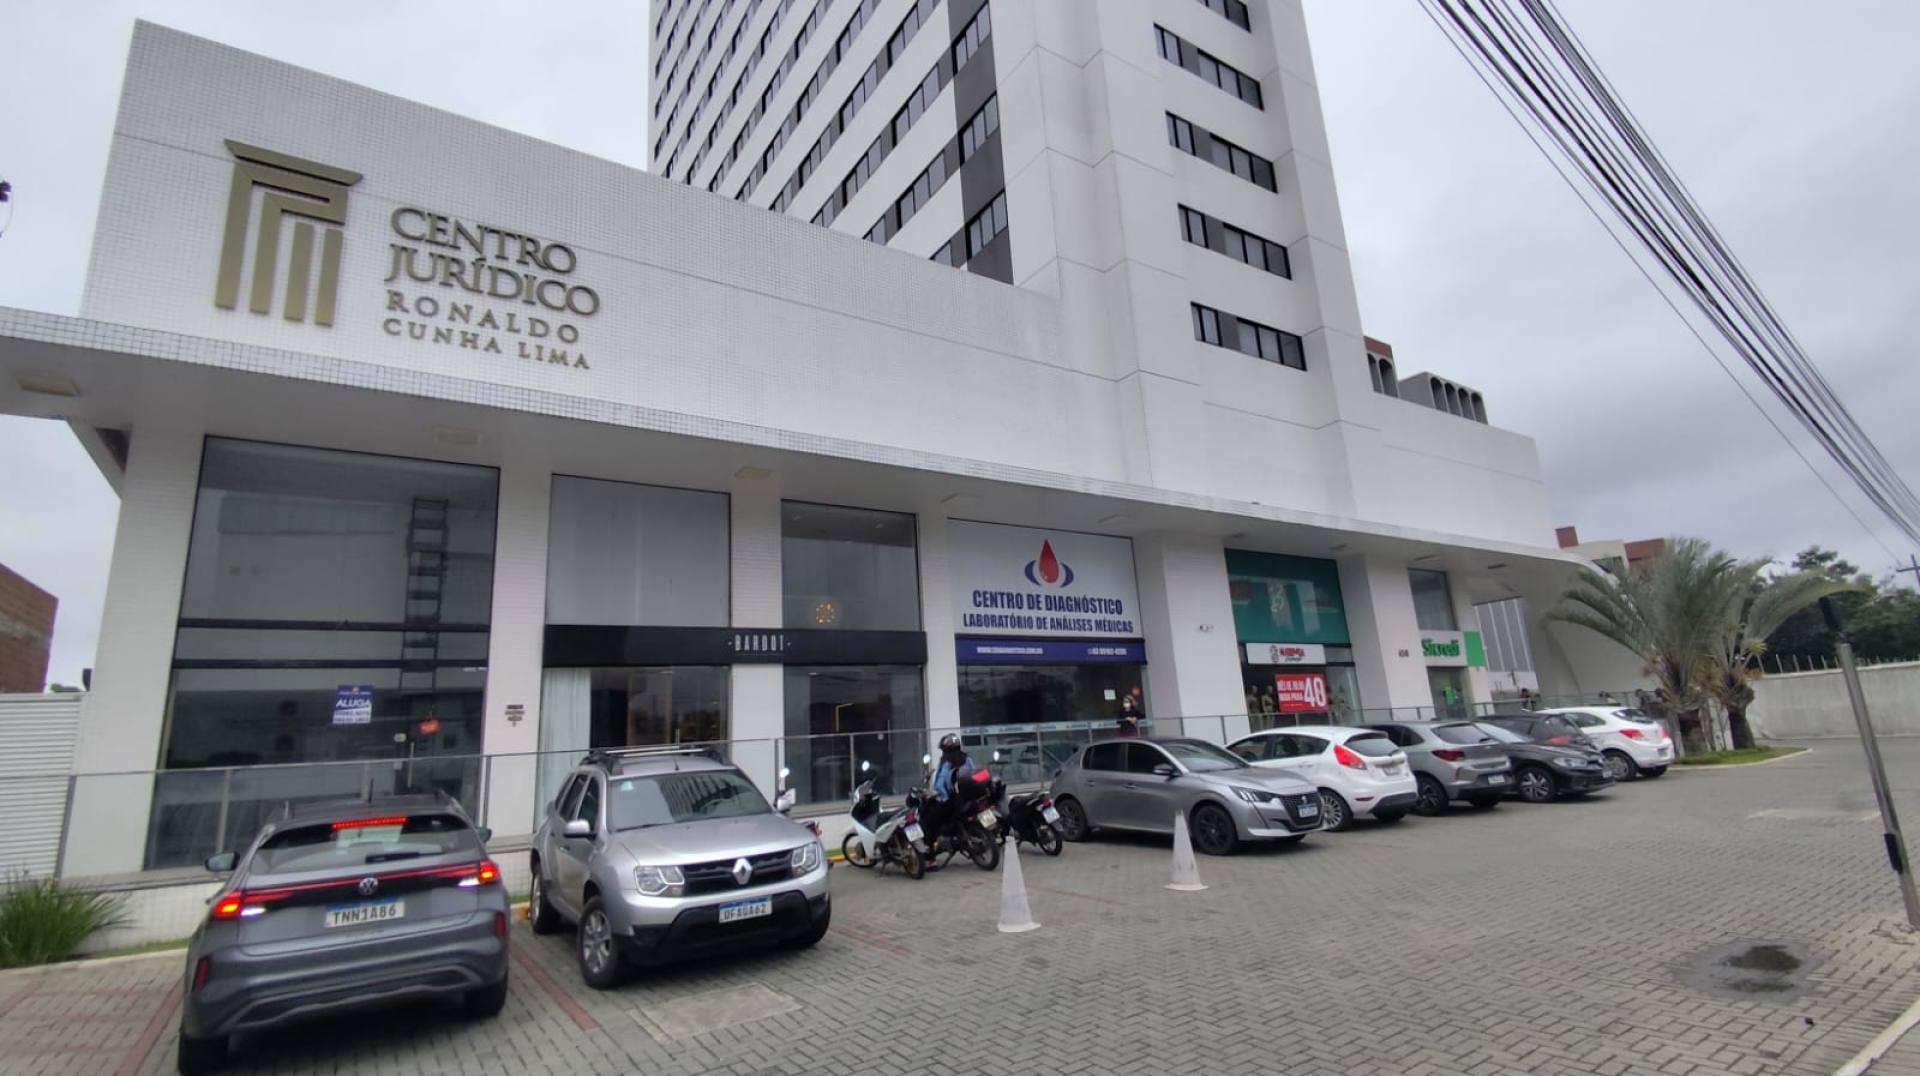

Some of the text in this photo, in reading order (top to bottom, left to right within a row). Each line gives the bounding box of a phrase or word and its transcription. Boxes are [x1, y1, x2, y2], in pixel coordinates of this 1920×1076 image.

[390, 207, 577, 274] CENTRO
[383, 243, 600, 316] JURÍDICO
[386, 289, 579, 344] RONALDO
[383, 318, 590, 370] CUNHA LIMA
[963, 612, 1134, 633] LABORATÓRIO DE ANÁLISES MÉDICAS
[973, 589, 1123, 615] CENTRO DE DIAGNÓSTICO
[1304, 677, 1328, 707] 40
